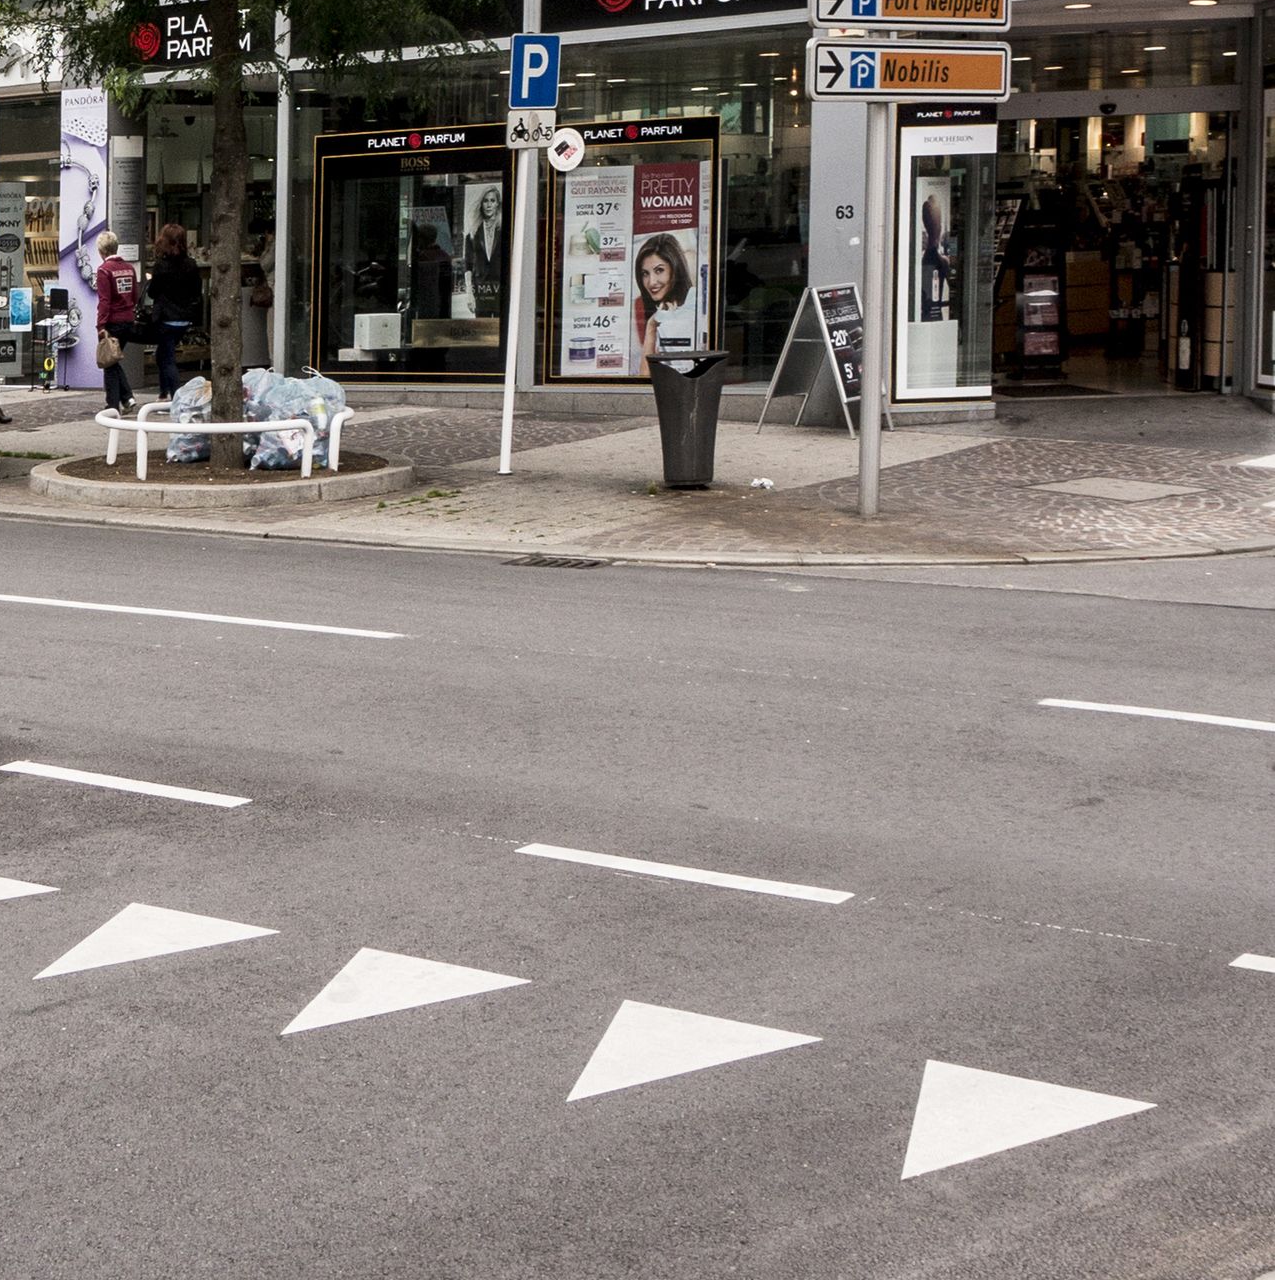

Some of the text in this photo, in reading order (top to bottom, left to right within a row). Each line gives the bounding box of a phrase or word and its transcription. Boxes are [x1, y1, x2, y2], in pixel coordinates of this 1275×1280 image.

[167, 9, 251, 37] PLAT
[167, 33, 251, 60] PARFM
[521, 44, 549, 99] P
[883, 59, 950, 83] Nobilis
[584, 125, 682, 139] PLANET PARFUM
[368, 133, 465, 149] PLANET PARFUM
[400, 156, 431, 169] BOSS
[641, 178, 694, 195] PRETTY
[640, 195, 693, 208] WOMAN
[835, 205, 854, 219] 63
